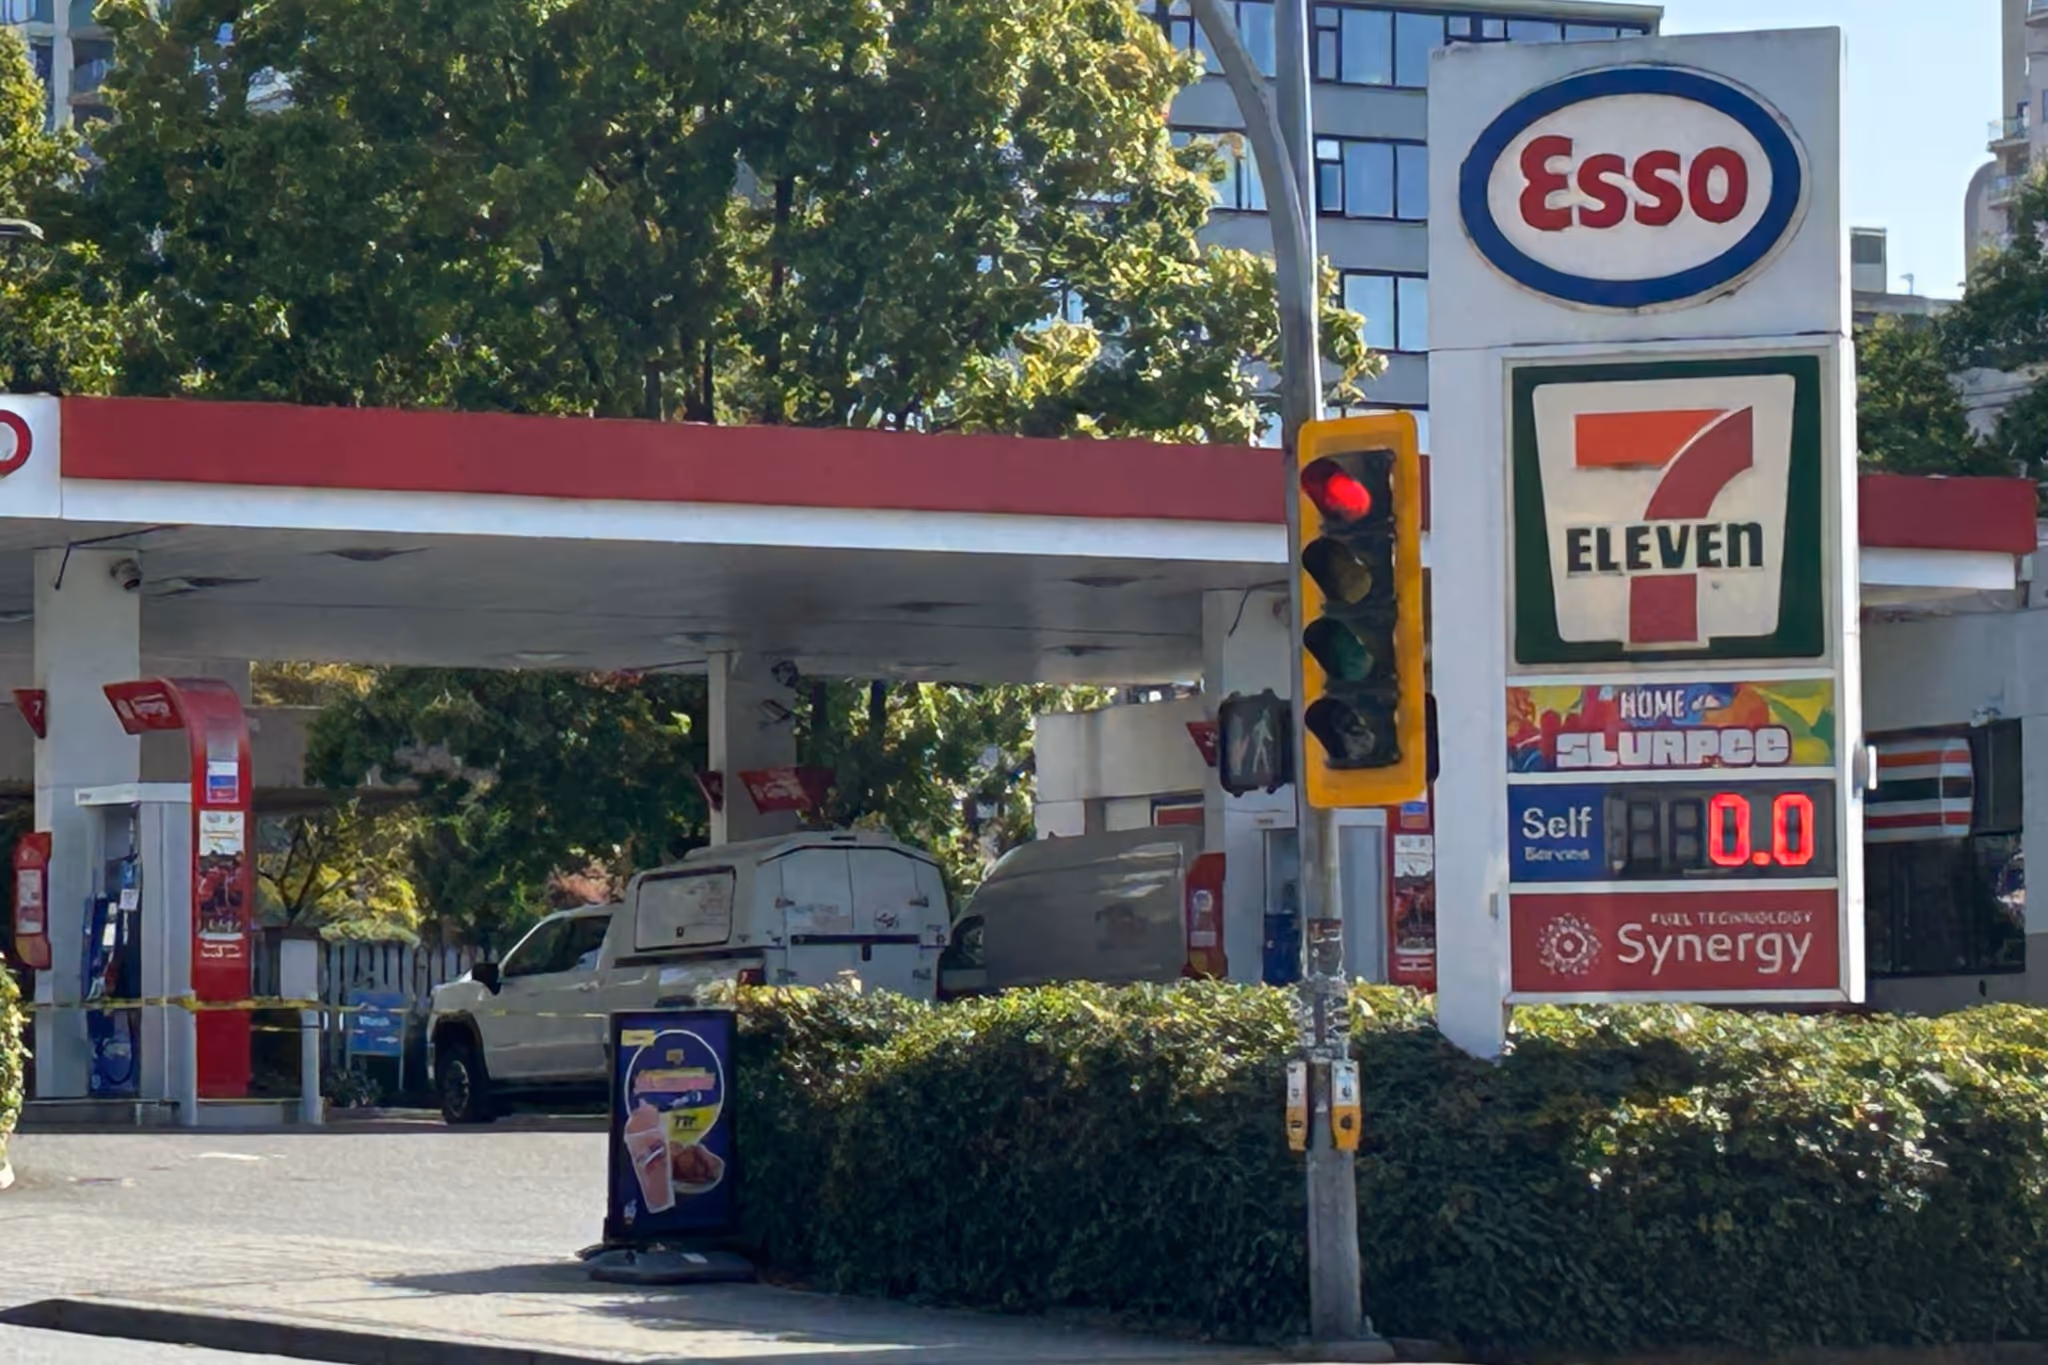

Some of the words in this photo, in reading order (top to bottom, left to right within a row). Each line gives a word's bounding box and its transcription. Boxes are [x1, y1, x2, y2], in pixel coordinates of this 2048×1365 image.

[1575, 406, 1754, 643] 7
[1619, 689, 1685, 720] HOME
[1522, 806, 1592, 839] Self
[1709, 792, 1815, 867] 0.0
[1617, 922, 1813, 977] Synergy
